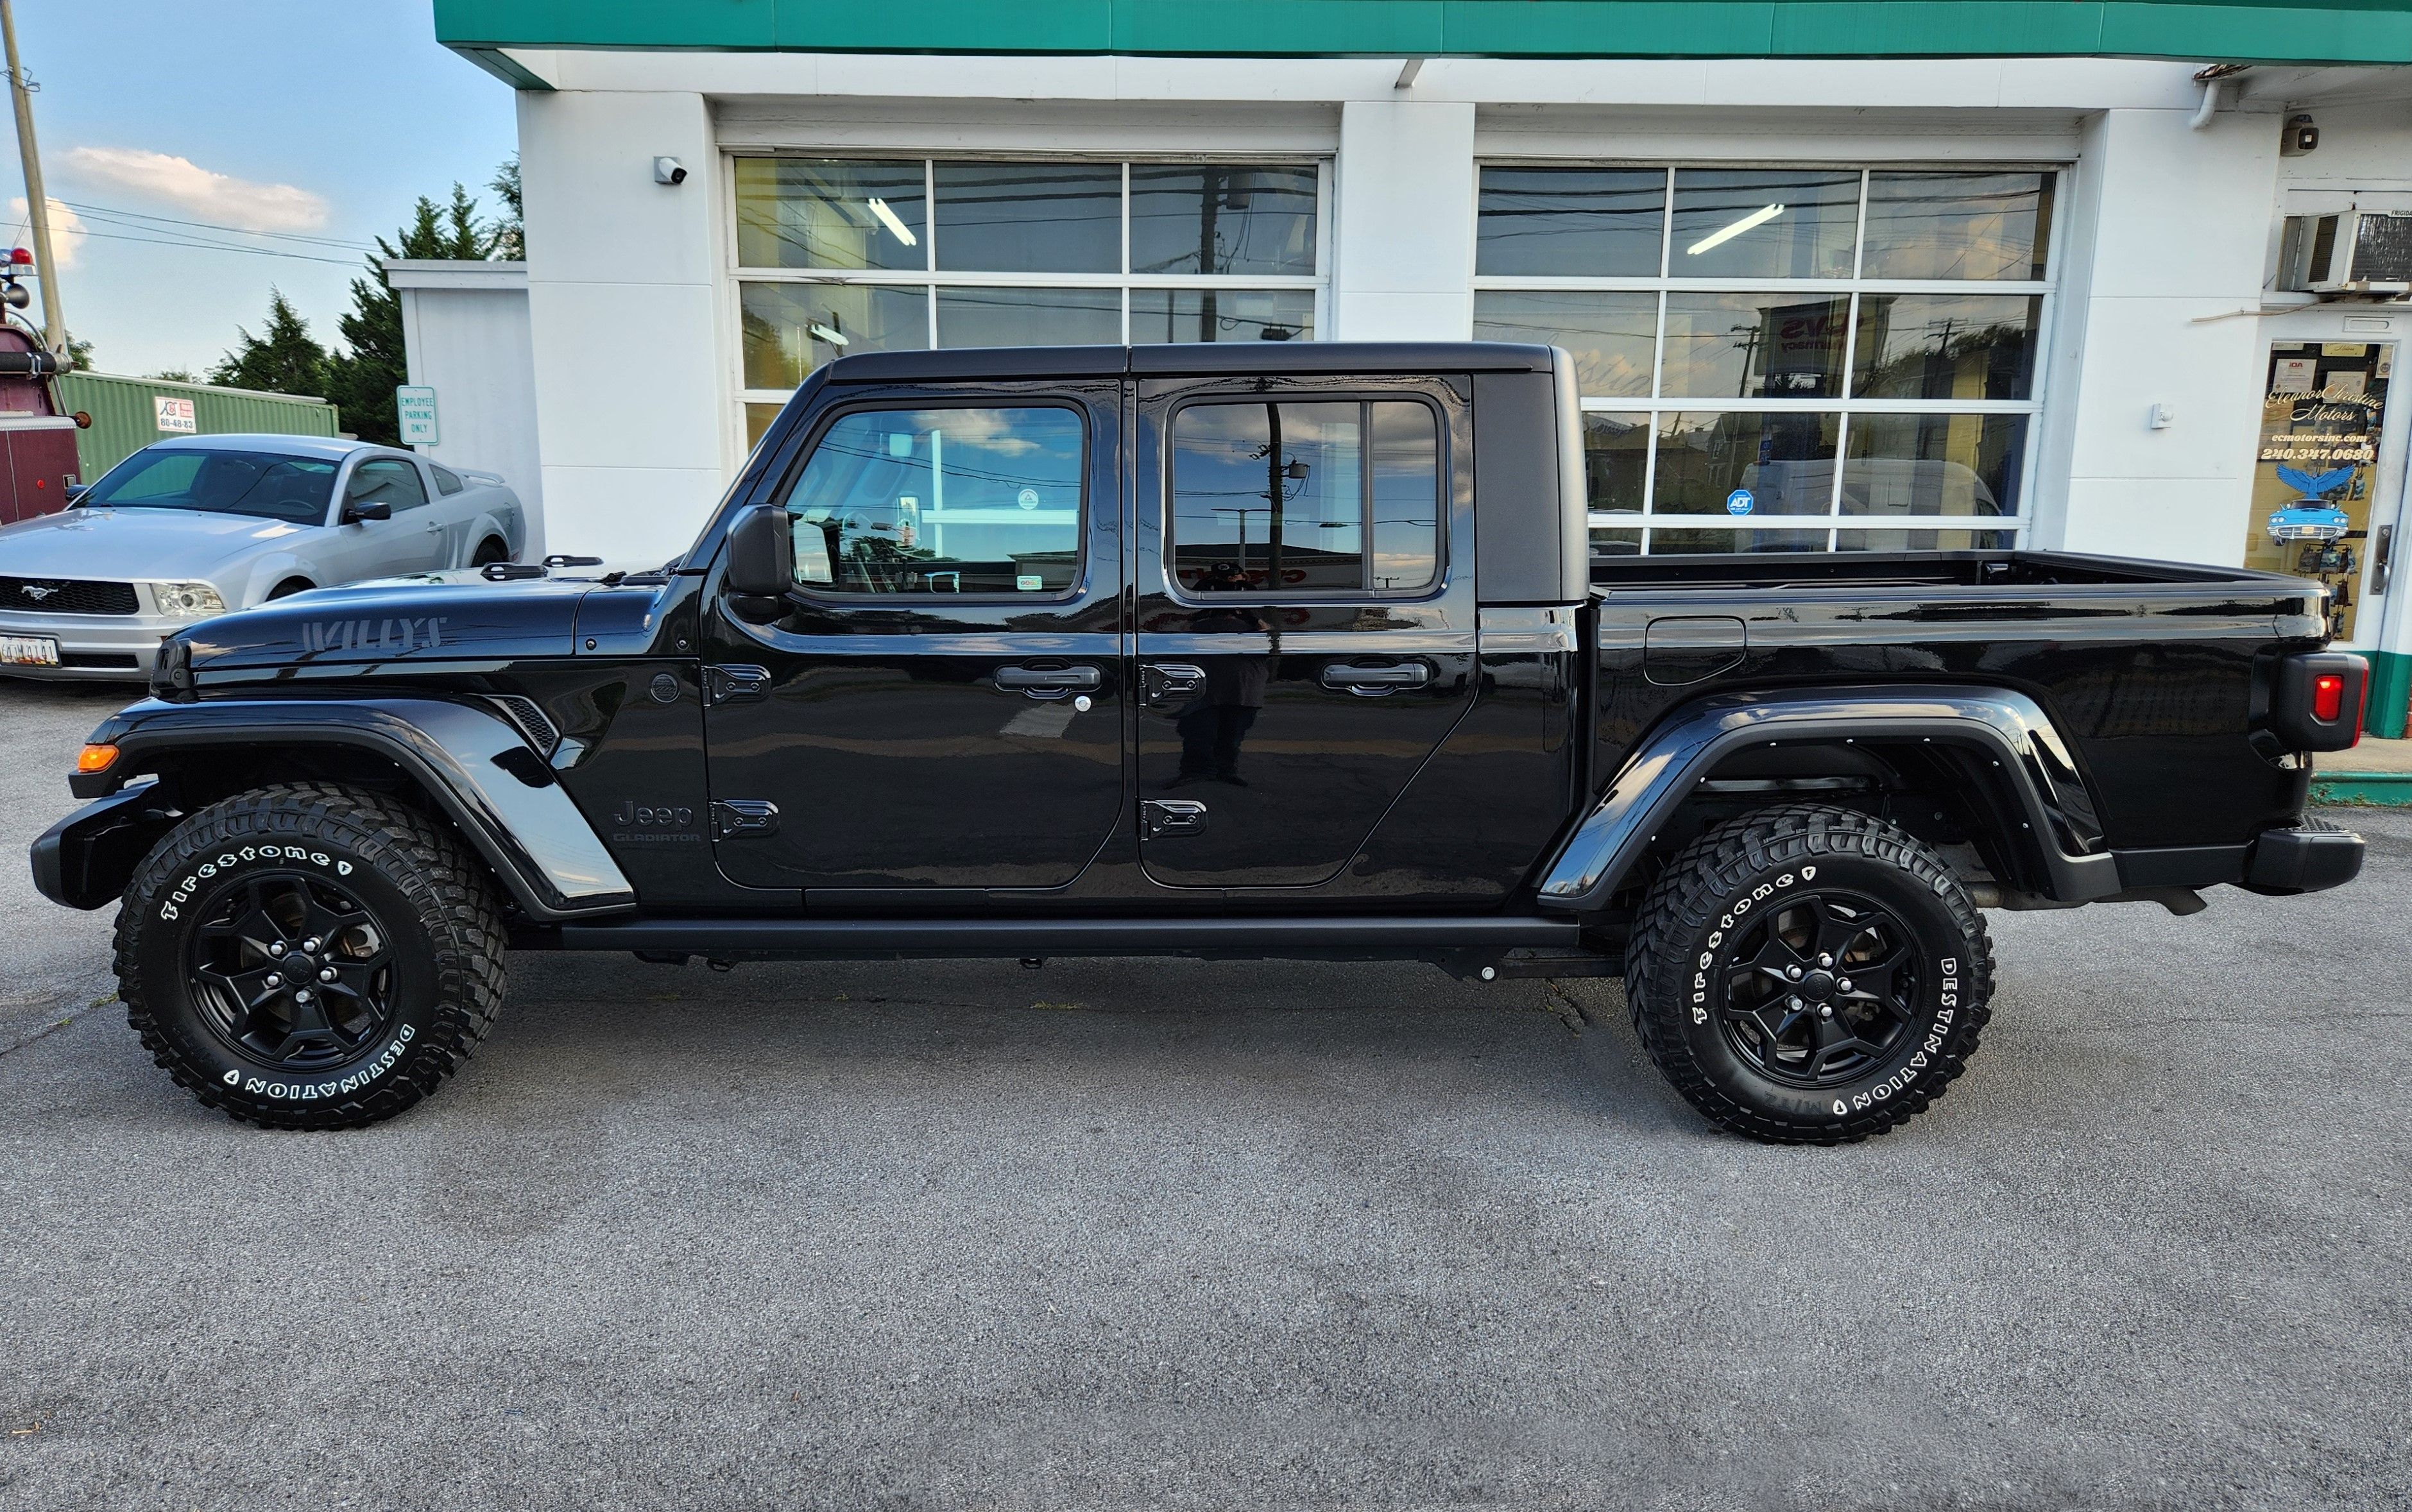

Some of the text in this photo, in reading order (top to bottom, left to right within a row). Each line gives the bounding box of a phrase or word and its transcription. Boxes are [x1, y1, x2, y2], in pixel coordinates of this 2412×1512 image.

[401, 397, 434, 407] EMPLOYEE
[2265, 384, 2383, 409] Eleanor Christine
[405, 411, 432, 420] PARKING
[2290, 403, 2357, 421] Motors
[411, 423, 427, 433] ONLY
[2271, 433, 2367, 443] ecmotorsinc.com
[2261, 448, 2374, 460] 240.347.0680
[1730, 497, 1751, 507] ADT
[302, 617, 448, 652] WILLYS
[613, 801, 694, 831] Jeep
[613, 833, 701, 842] GLADIATOR
[160, 845, 331, 921] Firestone
[1691, 873, 1794, 1024] Firestone
[1852, 957, 1958, 1111] DESTINATION
[245, 1023, 416, 1099] DESTINATION
